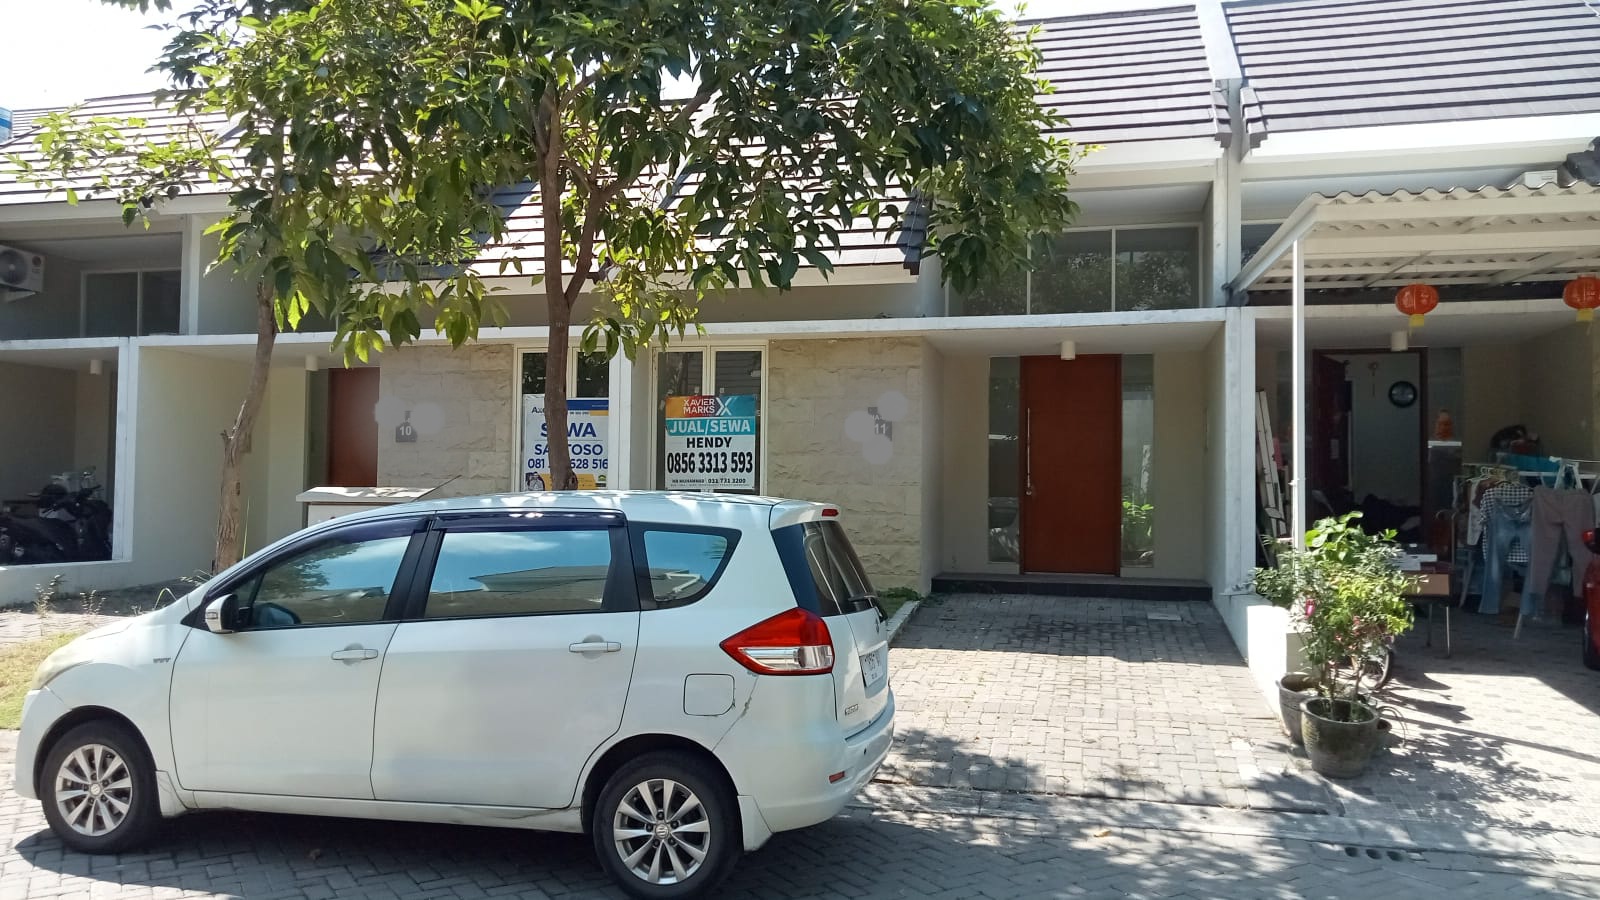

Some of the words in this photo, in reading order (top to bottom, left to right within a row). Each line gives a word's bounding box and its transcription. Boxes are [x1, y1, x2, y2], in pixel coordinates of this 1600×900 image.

[683, 398, 715, 406] XAVIER
[683, 405, 715, 414] MARKS
[399, 425, 412, 436] 10
[540, 422, 597, 438] SWA
[669, 419, 751, 435] JUAL/SEWA
[686, 437, 733, 449] HENDY
[527, 458, 545, 469] 081
[592, 458, 609, 470] 516
[667, 452, 696, 474] 0856
[698, 452, 728, 474] 3313
[730, 451, 754, 474] 593
